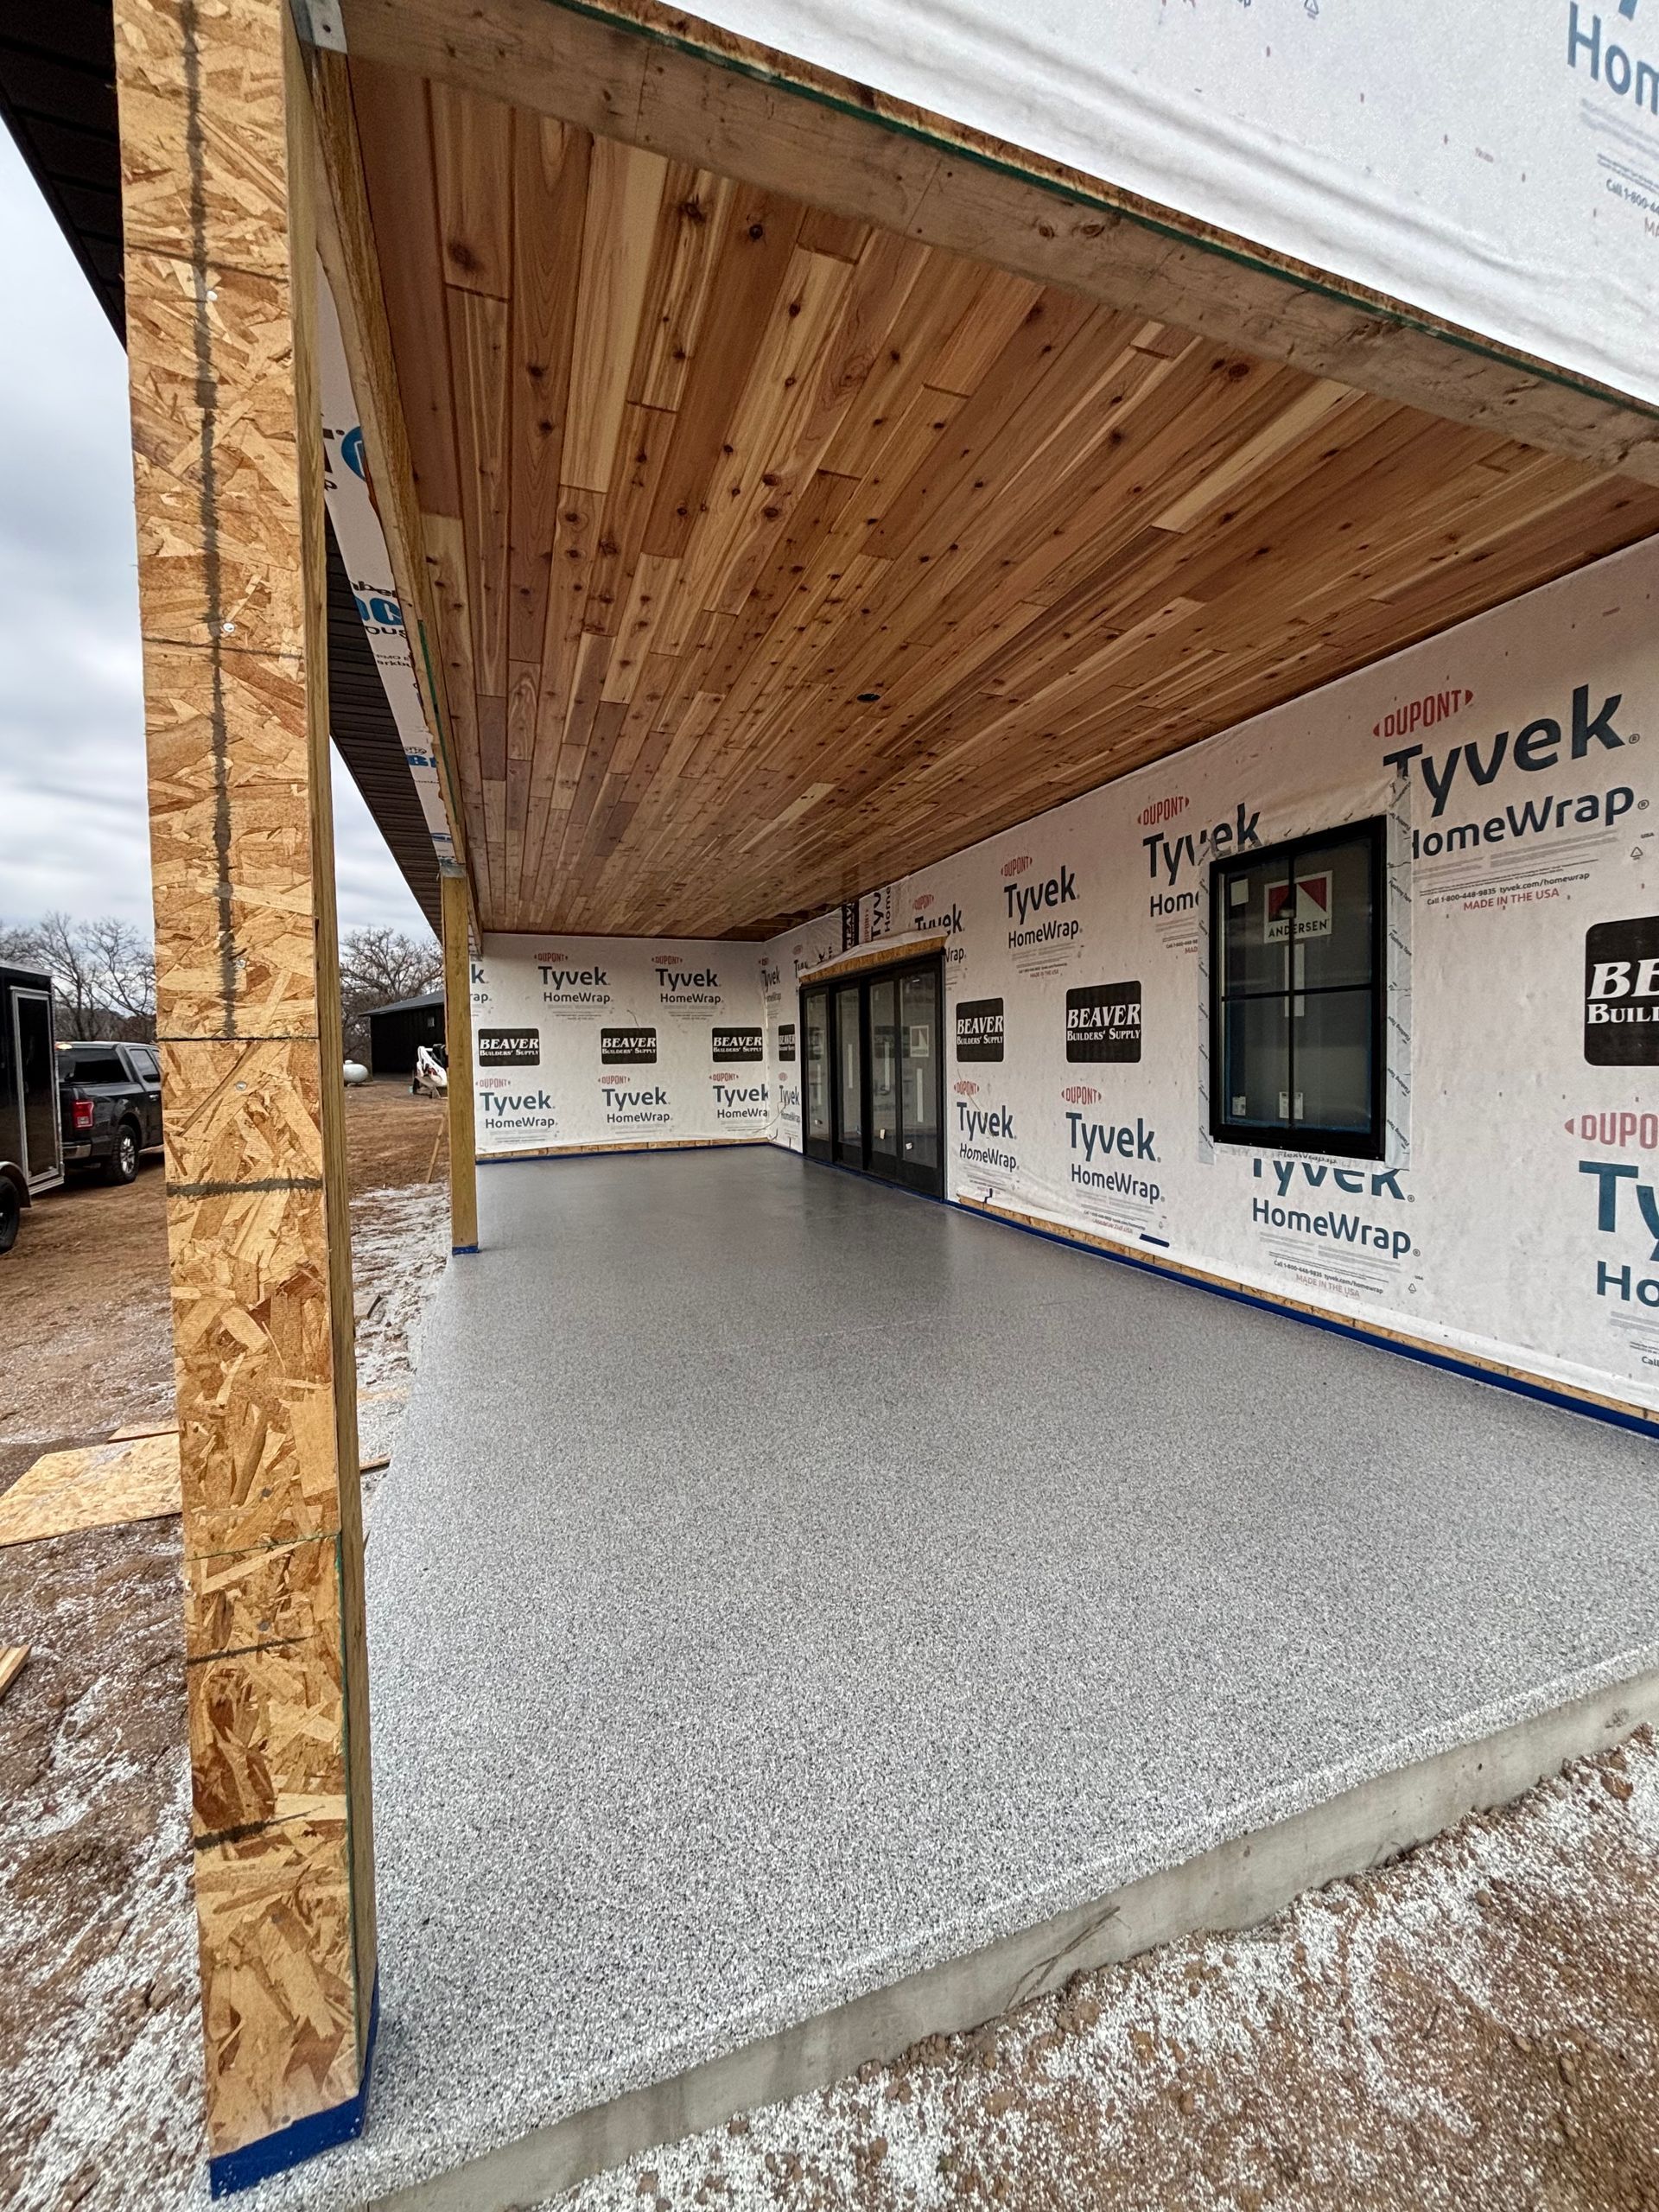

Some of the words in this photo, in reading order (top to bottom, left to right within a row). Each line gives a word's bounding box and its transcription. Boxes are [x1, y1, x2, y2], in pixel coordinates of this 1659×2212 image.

[1384, 690, 1461, 738] DUPONT
[1143, 796, 1185, 825] DUPONT
[1004, 856, 1030, 877] DUPONT
[1004, 865, 1076, 925] Tyvek
[1441, 888, 1497, 903] 1-800-448-9835
[1500, 873, 1590, 893] tyvek.com/homewrap
[1464, 899, 1494, 911] MADE
[1497, 896, 1508, 906] IN
[1510, 892, 1533, 904] THE
[1536, 888, 1560, 900] USA
[1008, 919, 1079, 949] HomeWrap
[537, 952, 565, 963] DUPONT
[537, 966, 607, 990] Tyvek
[655, 968, 719, 992] Tyvek
[543, 991, 611, 1004] HomeWrap
[660, 993, 721, 1005] HomeWrap
[957, 1015, 1003, 1035] BEAVER
[1066, 1003, 1141, 1028] BEAVER
[480, 1039, 539, 1050] BEAVER
[602, 1037, 657, 1048] BEAVER
[713, 1036, 762, 1047] BEAVER
[1109, 1027, 1141, 1041] SUPPLY
[480, 1078, 507, 1088] DUPONT
[601, 1075, 627, 1084] DUPONT
[713, 1072, 736, 1082] DUPONT
[480, 1090, 551, 1116] Tyvek
[601, 1086, 667, 1112] Tyvek
[1065, 1086, 1097, 1105] DUPONT
[485, 1116, 555, 1129] HomeWrap
[607, 1112, 671, 1123] HomeWrap
[957, 1102, 1014, 1141] Tyvek
[1065, 1111, 1157, 1162] Tyvek
[959, 1143, 1017, 1172] HomeWrap
[1071, 1163, 1160, 1204] HomeWrap
[1253, 1198, 1412, 1259] HomeWrap
[1296, 1274, 1317, 1287] MADE
[1319, 1281, 1327, 1289] IN
[1329, 1282, 1343, 1294] THE
[1344, 1287, 1360, 1298] USA
